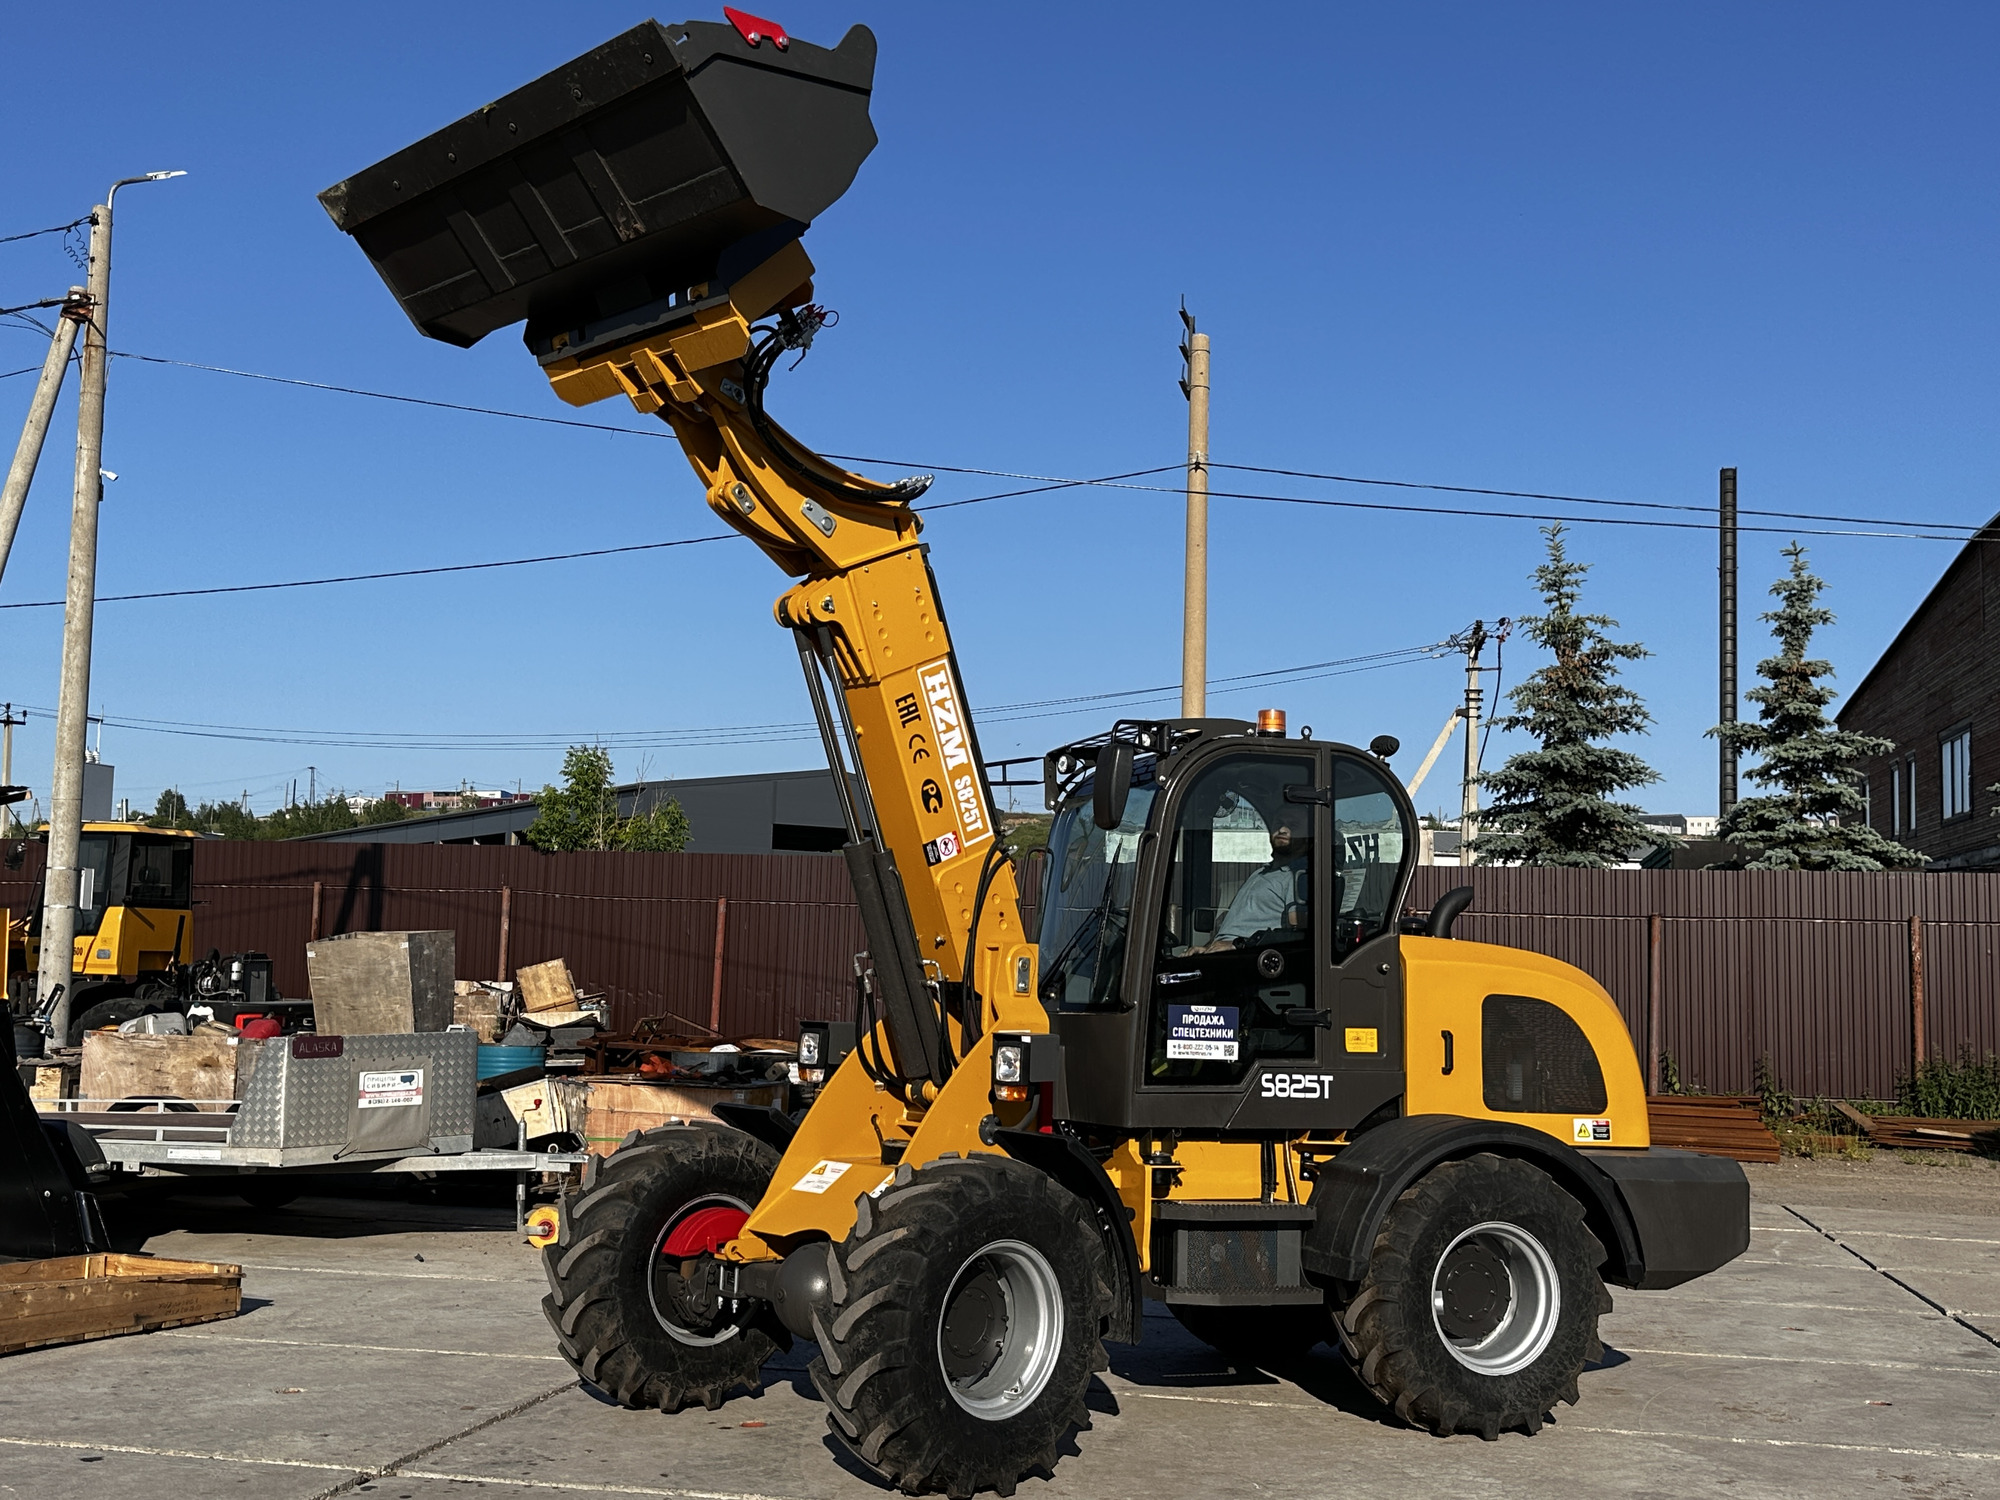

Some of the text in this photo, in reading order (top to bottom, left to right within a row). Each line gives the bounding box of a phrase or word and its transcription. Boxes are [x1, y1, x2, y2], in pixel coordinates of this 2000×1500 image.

[909, 733, 930, 764] CE
[924, 671, 983, 833] HZM S825T
[1182, 1014, 1225, 1026] ПРОДАЖА
[1172, 1027, 1234, 1039] СПЕЦТЕХНИКИ
[298, 1041, 338, 1054] ALASKA
[1261, 1073, 1334, 1099] S825T
